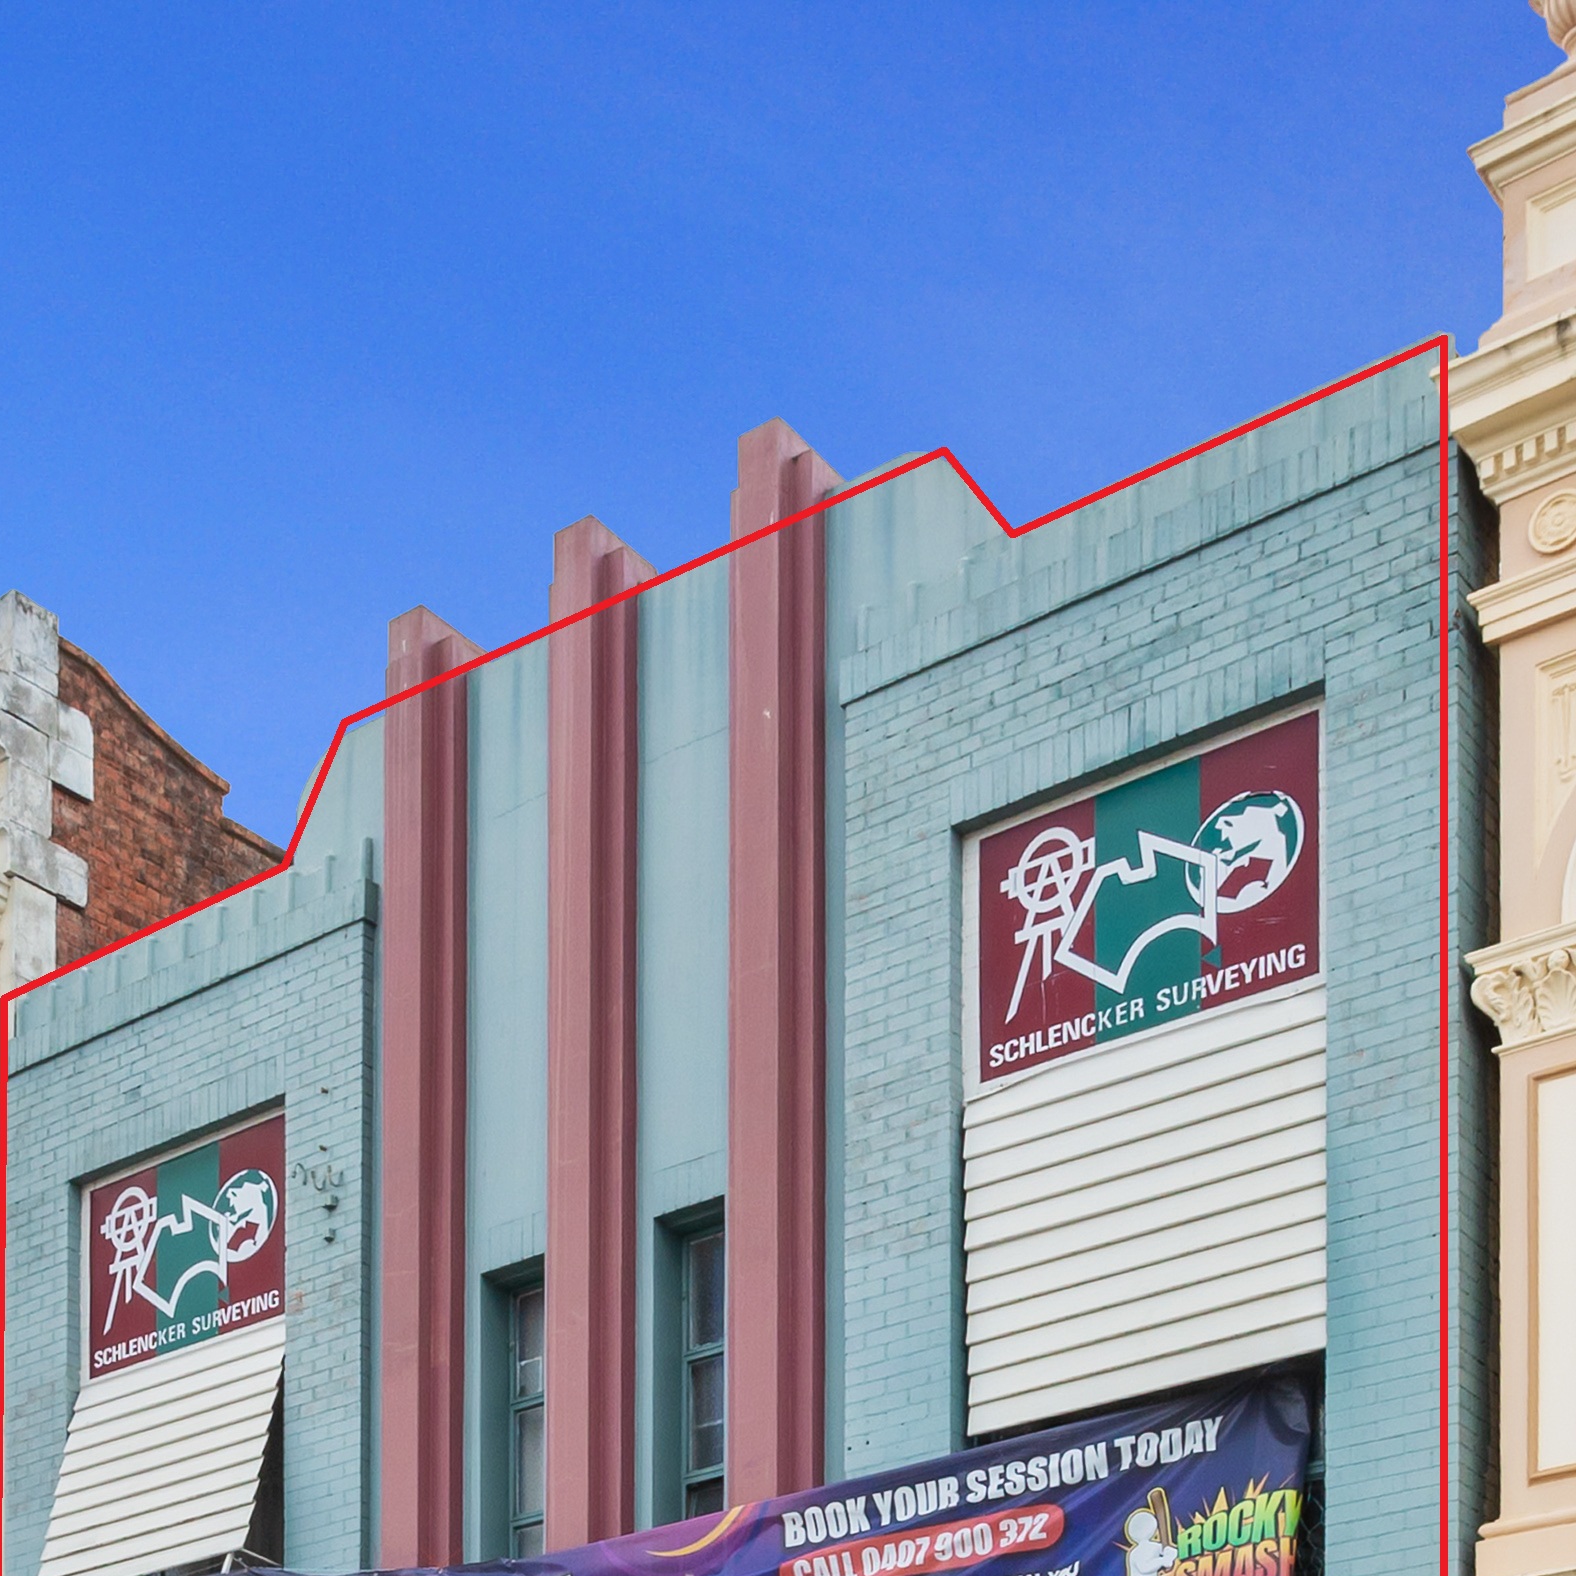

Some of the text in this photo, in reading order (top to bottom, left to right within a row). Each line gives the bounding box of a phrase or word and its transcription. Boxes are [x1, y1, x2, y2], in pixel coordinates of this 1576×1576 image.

[989, 943, 1306, 1068] SCHLENCKER SURVEYING
[93, 1290, 280, 1369] SCHLENCKER SURVEYING
[782, 1416, 1224, 1548] BOOK YOUR SESSION TODAY
[934, 1523, 993, 1562] 900
[999, 1512, 1050, 1548] 372
[1177, 1489, 1303, 1560] ROCKY
